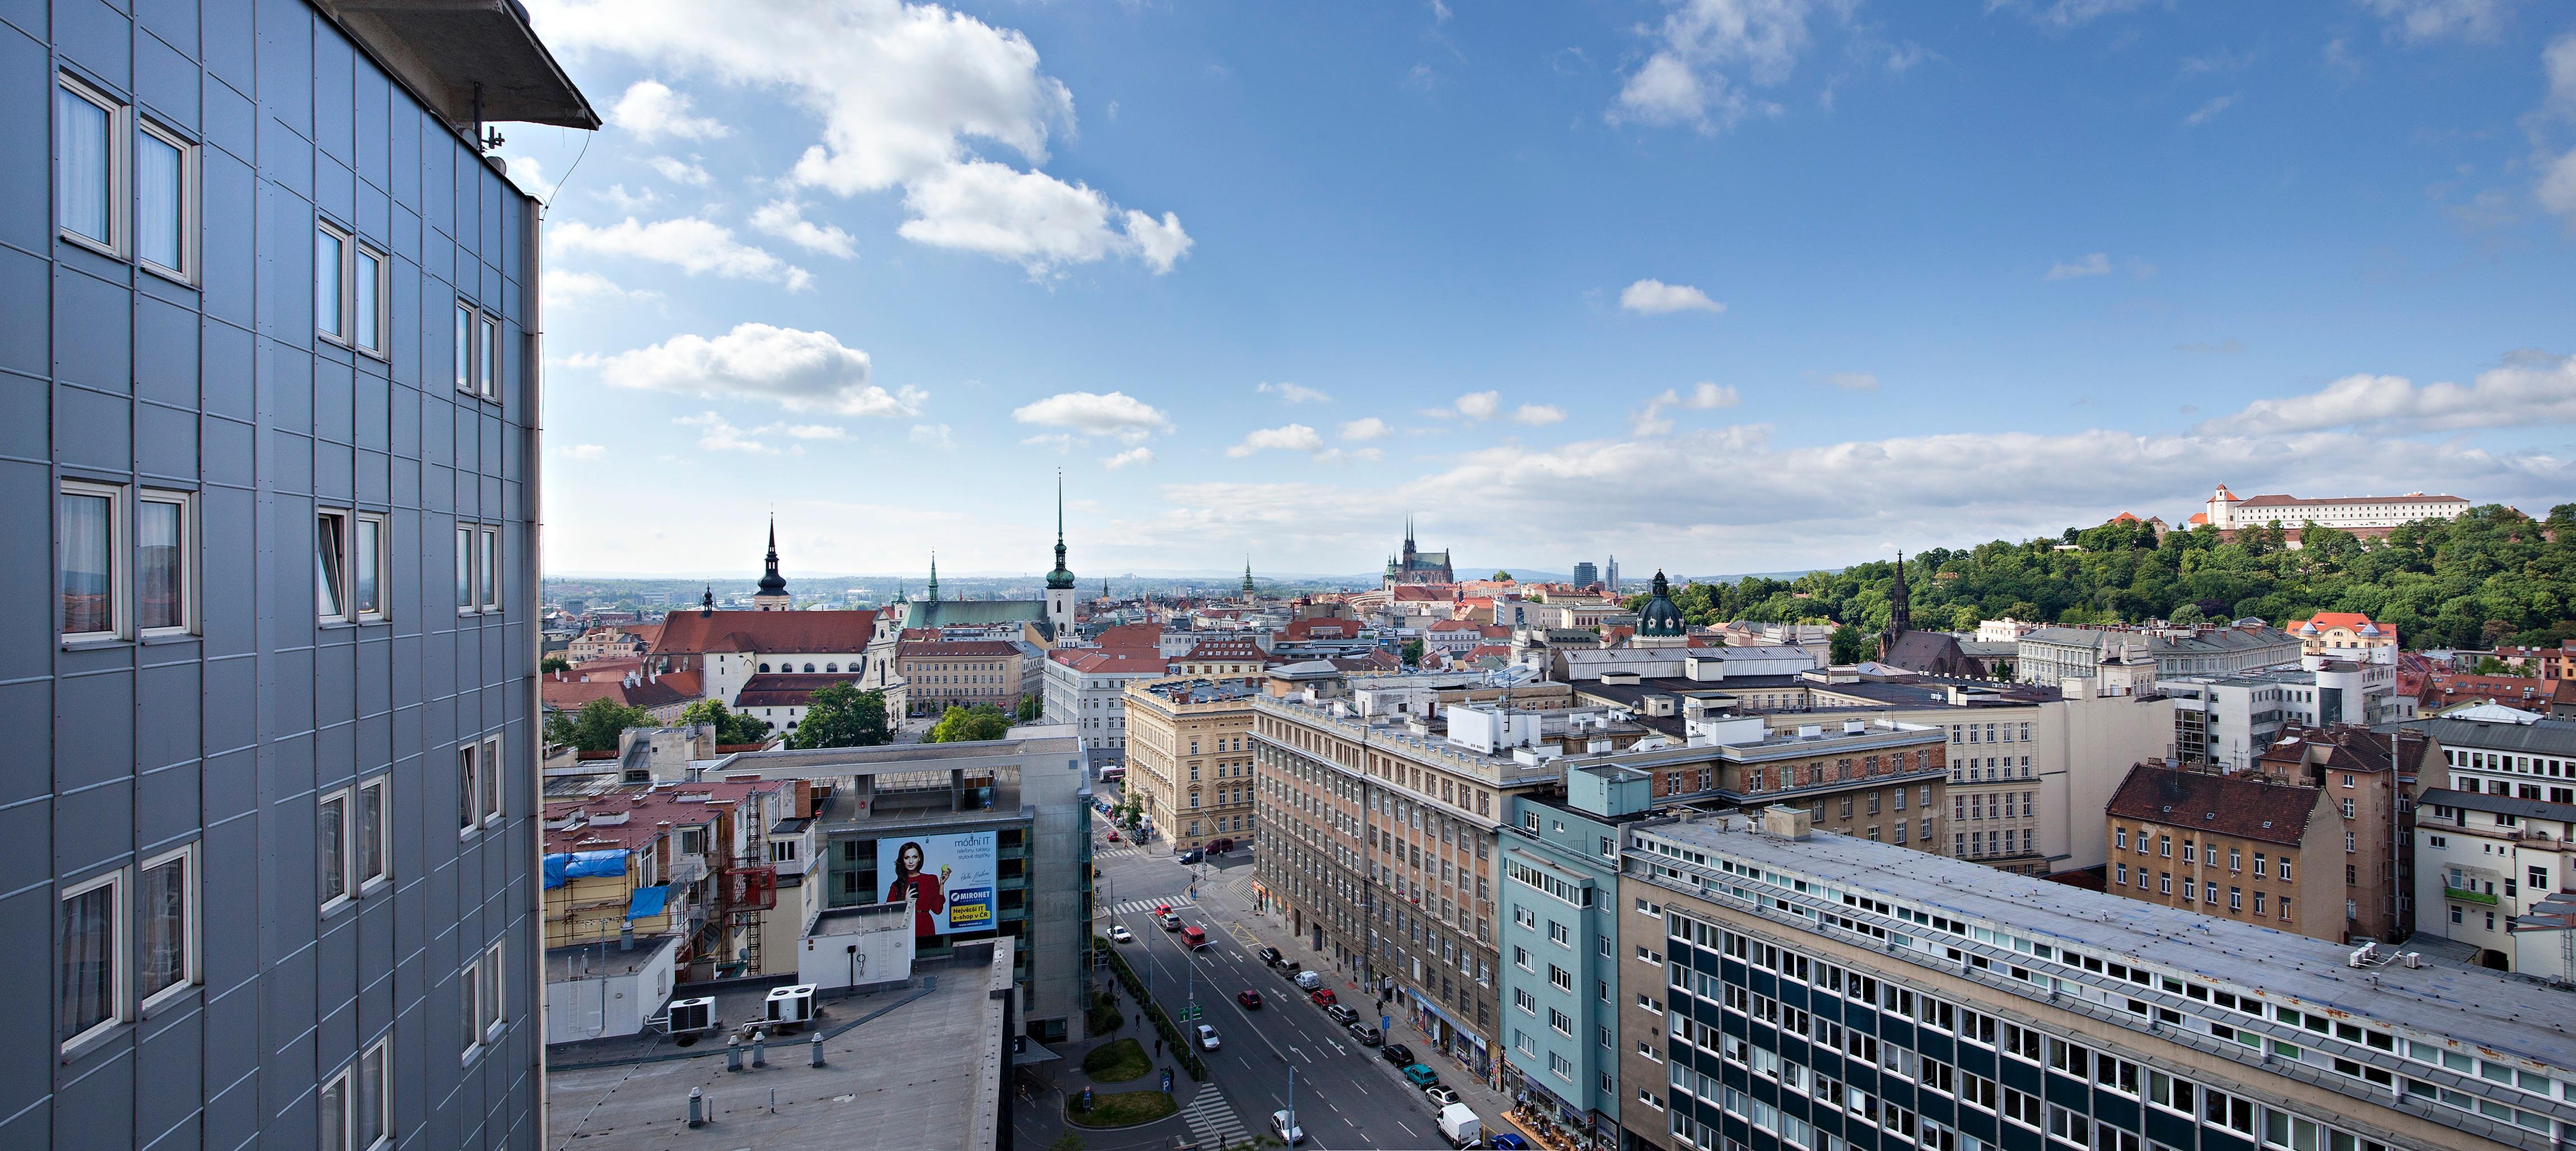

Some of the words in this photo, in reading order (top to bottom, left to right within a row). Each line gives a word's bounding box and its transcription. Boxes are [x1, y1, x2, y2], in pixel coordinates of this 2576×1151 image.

[955, 837, 981, 847] módní
[983, 836, 991, 845] IT
[960, 891, 990, 900] MIRONET
[1164, 1080, 1169, 1091] P
